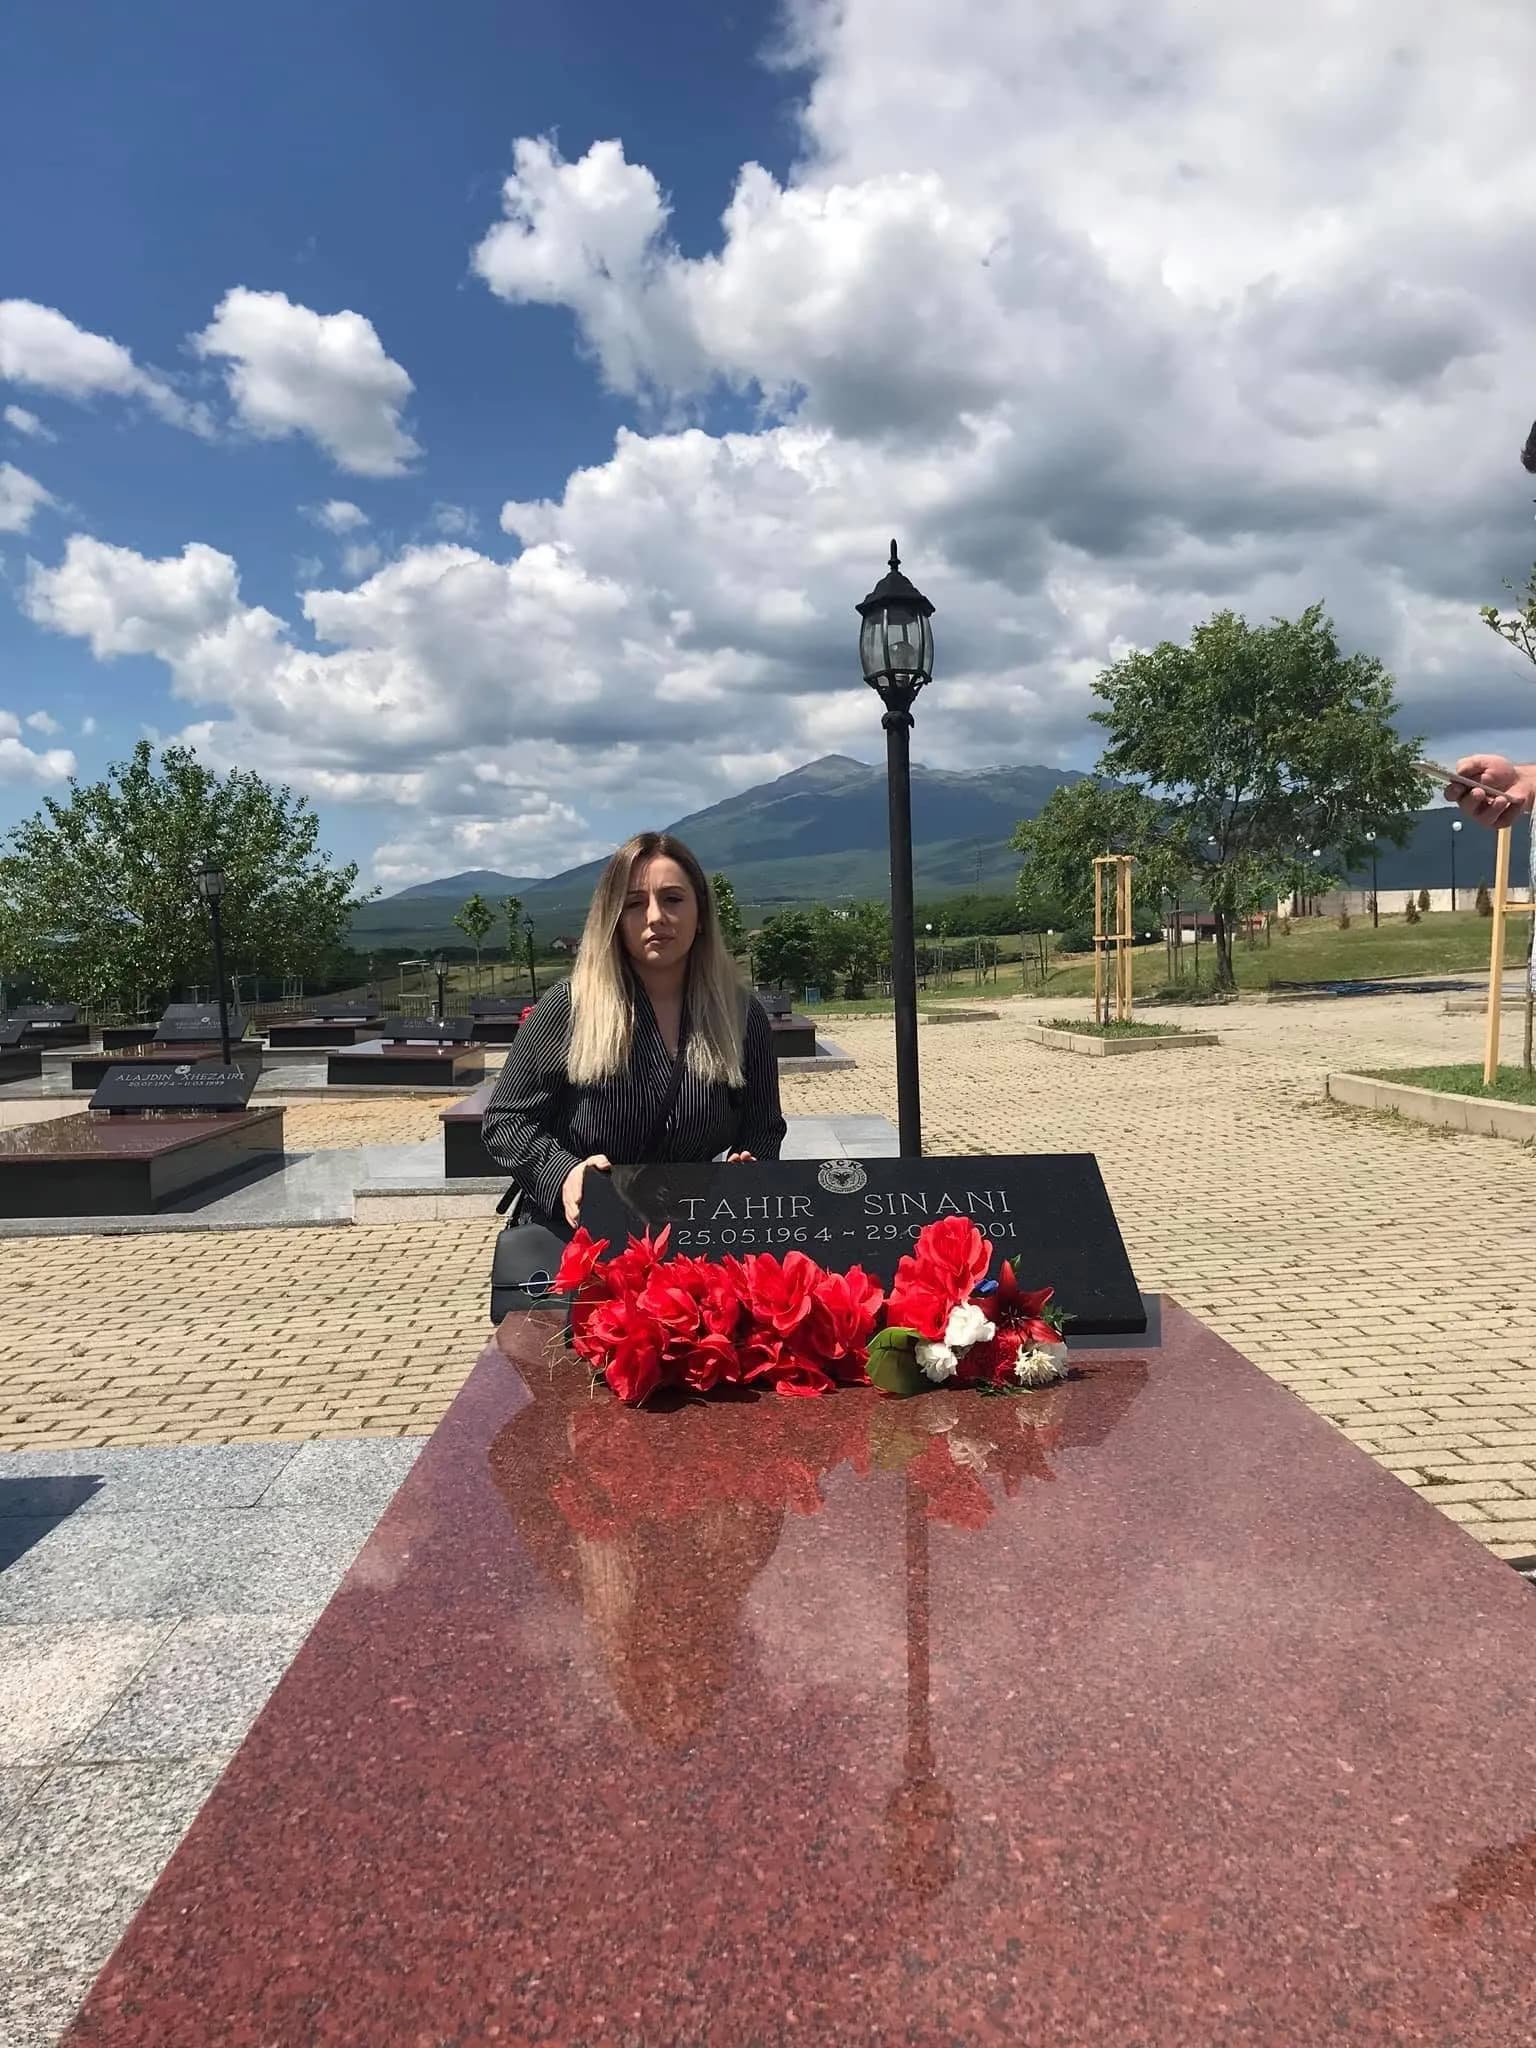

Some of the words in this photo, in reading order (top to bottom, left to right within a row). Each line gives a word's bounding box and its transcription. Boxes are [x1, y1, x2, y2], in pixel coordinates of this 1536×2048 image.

[678, 1195, 814, 1221] TAHIR
[863, 1190, 1013, 1216] SINANI
[677, 1226, 832, 1245] 25.05.1964
